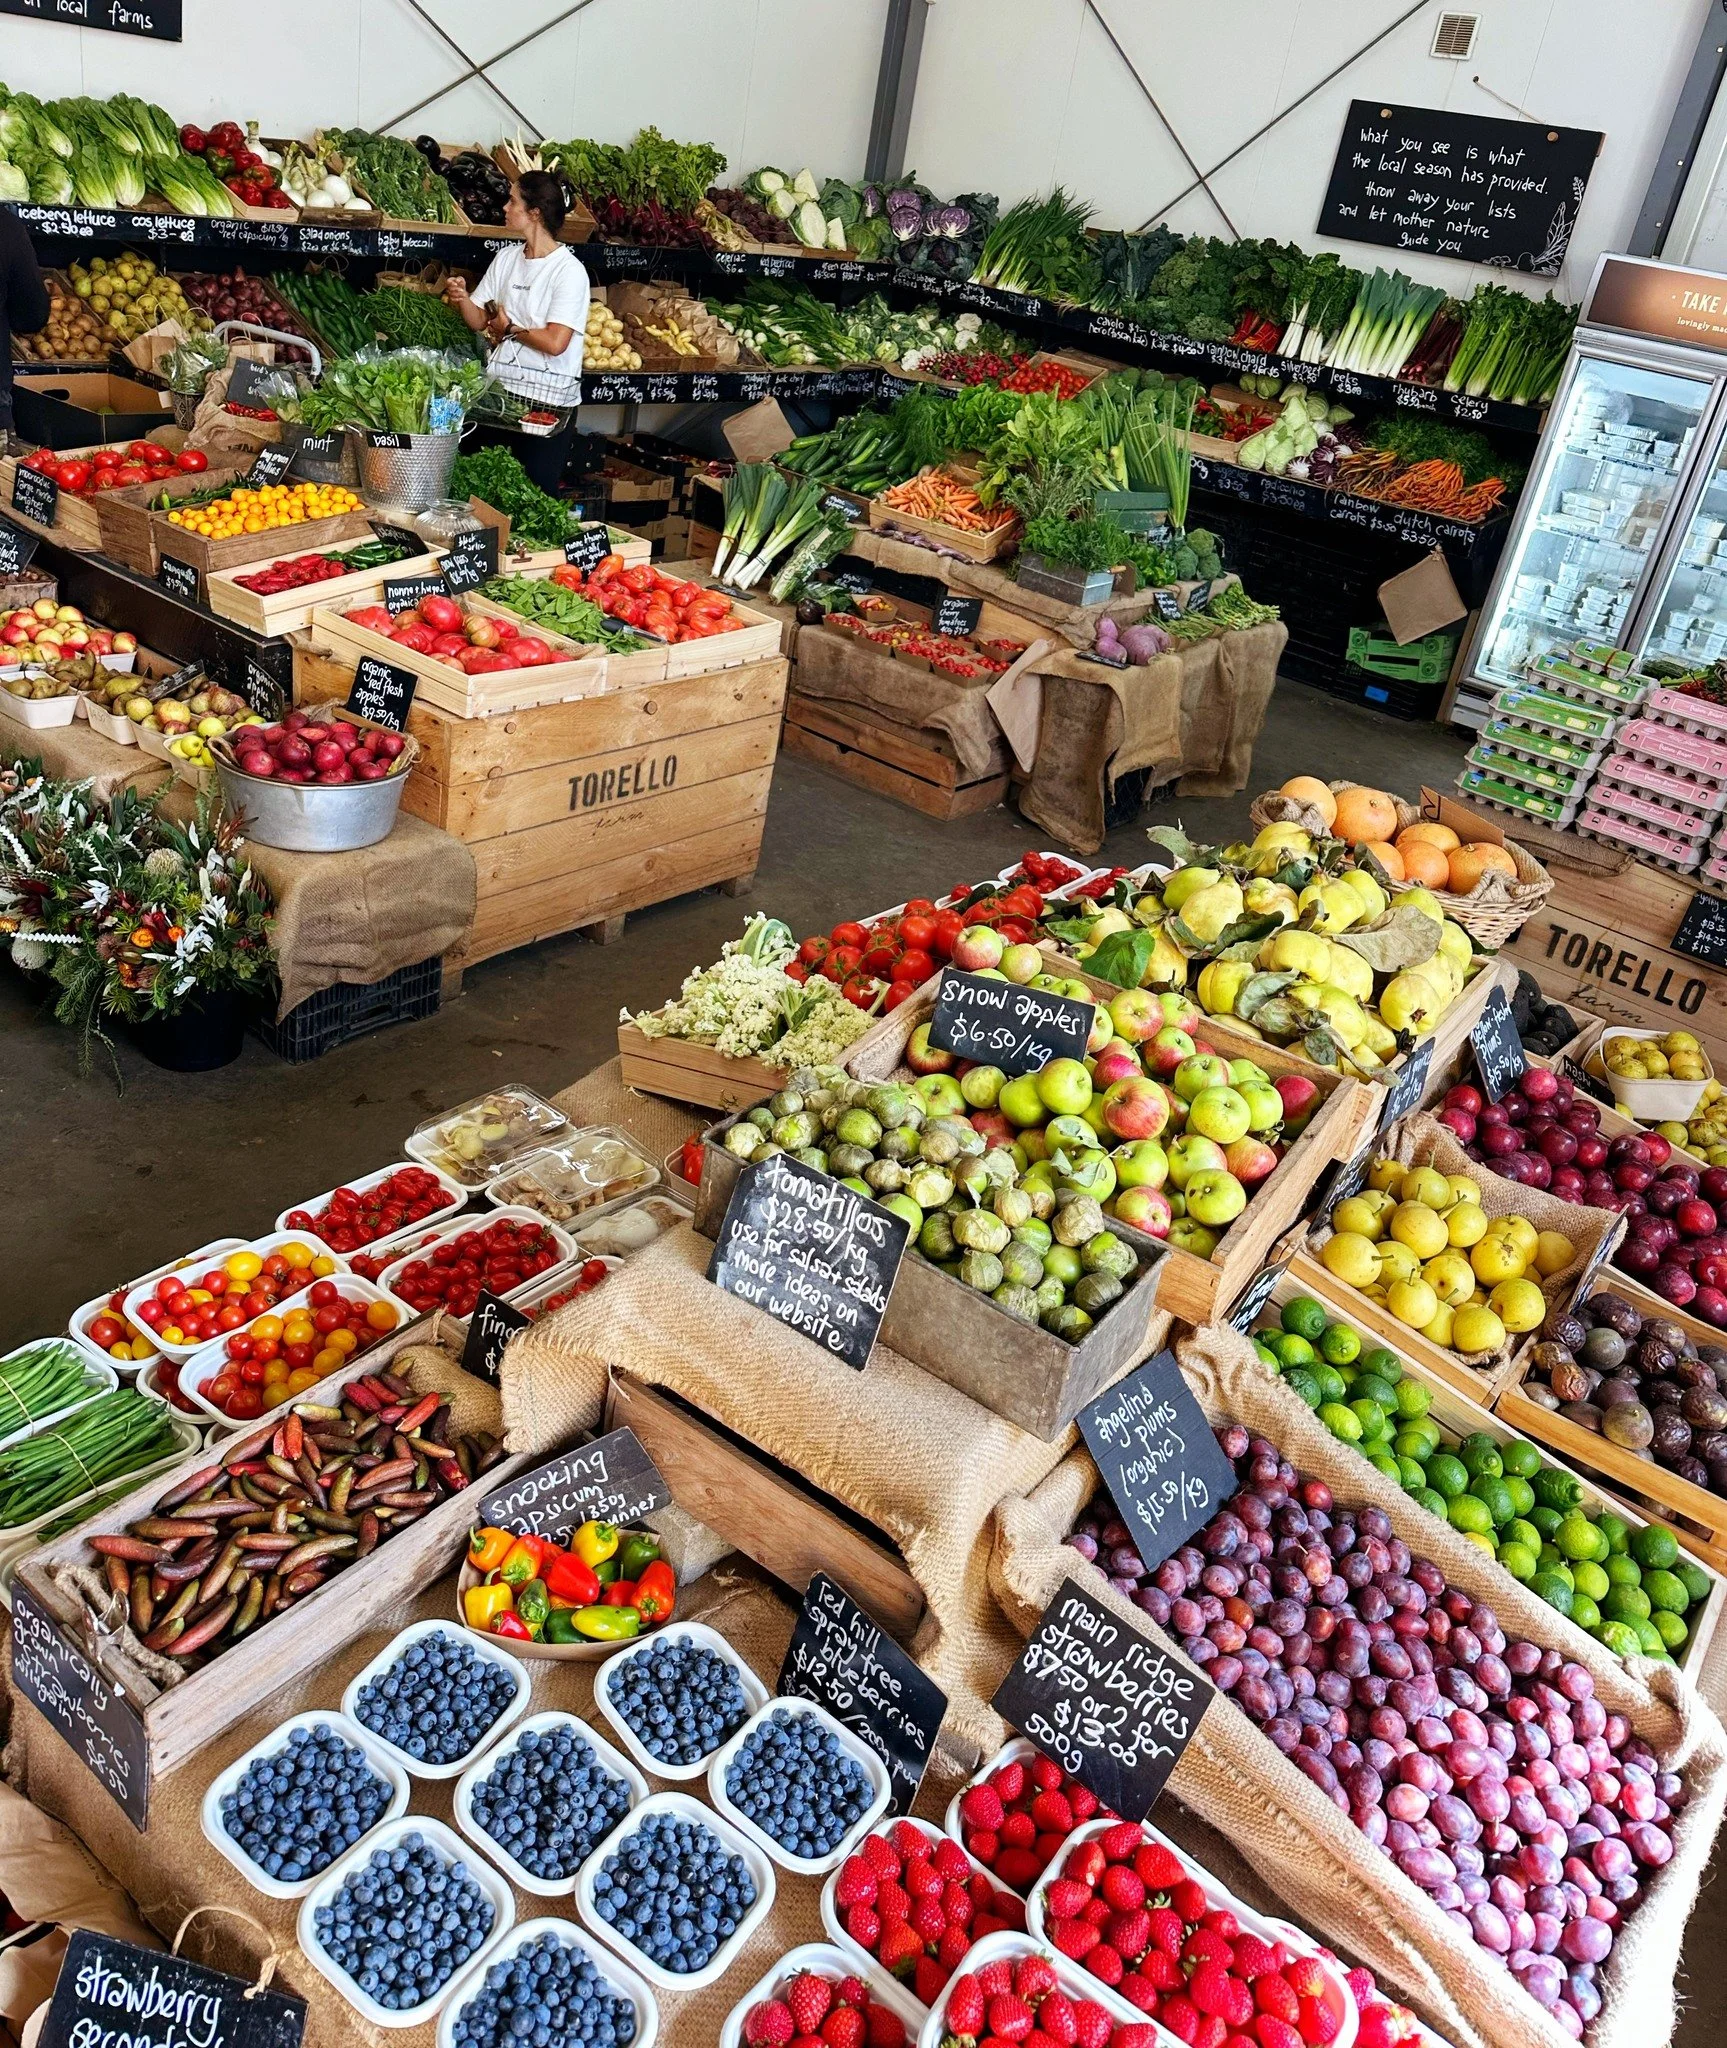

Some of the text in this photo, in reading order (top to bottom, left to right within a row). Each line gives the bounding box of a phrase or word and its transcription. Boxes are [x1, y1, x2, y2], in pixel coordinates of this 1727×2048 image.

[56, 0, 153, 29] local farms
[1396, 136, 1422, 153] you
[1432, 141, 1450, 155] see
[1466, 145, 1478, 160] is
[1489, 147, 1525, 167] what
[1352, 152, 1548, 195] the local season has provided.
[18, 204, 116, 228] iceberg lettuce
[1365, 182, 1516, 219] throw away your lists
[132, 216, 195, 230] cos lettuce
[180, 231, 195, 242] ea
[211, 219, 250, 234] organic
[324, 230, 350, 241] onions
[1338, 204, 1490, 238] and let mother nature
[222, 229, 277, 247] red capsicum
[377, 231, 435, 250] baby broccoli
[1398, 232, 1463, 253] guide you.
[1682, 291, 1721, 314] TAKE
[1677, 317, 1711, 332] lovingly
[1207, 342, 1267, 367] rainbow chard
[1330, 369, 1359, 386] leeks
[1392, 384, 1438, 402] rhubarb
[1450, 394, 1489, 414] celery
[1454, 406, 1483, 420] $2.50
[302, 434, 335, 452] mint
[373, 434, 400, 448] basil
[15, 491, 44, 511] tomatoes
[1330, 509, 1397, 532] carrots $5.50
[1394, 511, 1475, 546] dutch carrots
[1401, 530, 1438, 546] $3.50
[420, 580, 445, 595] hugo's
[248, 664, 274, 691] organic
[362, 662, 391, 681] organic
[247, 677, 269, 702] apples
[355, 688, 385, 706] apples
[368, 678, 403, 698] red flesh
[568, 755, 677, 811] TORELLO
[1692, 940, 1711, 954] $15
[1545, 924, 1707, 1015] TORELLO
[942, 979, 1080, 1036] snow apples
[1568, 983, 1646, 1025] farm
[950, 1012, 1052, 1073] $6.50/kg
[1480, 1030, 1502, 1063] plums
[764, 1154, 892, 1248] tomatillos
[760, 1193, 869, 1276] $28.50/kg
[731, 1220, 759, 1246] use
[763, 1228, 790, 1257] for
[788, 1248, 832, 1279] salsa
[842, 1275, 886, 1313] salads
[732, 1249, 858, 1326] more ideas on
[735, 1280, 845, 1351] our website
[1095, 1386, 1154, 1448] angelina
[1134, 1400, 1178, 1453] plums
[491, 1450, 609, 1520] snacking
[817, 1581, 882, 1653] Ted hill
[13, 1617, 60, 1673] grown
[16, 1600, 108, 1711] organically
[808, 1605, 858, 1666] spray
[861, 1652, 902, 1698] free
[1059, 1597, 1195, 1700] main ridge
[820, 1636, 926, 1750] blueberries
[1041, 1623, 1189, 1740] strawberries
[1025, 1712, 1083, 1773] 500g
[1081, 1695, 1110, 1718] or
[1106, 1706, 1128, 1737] 2
[1130, 1721, 1175, 1759] for
[74, 1955, 222, 2047] strawberry
